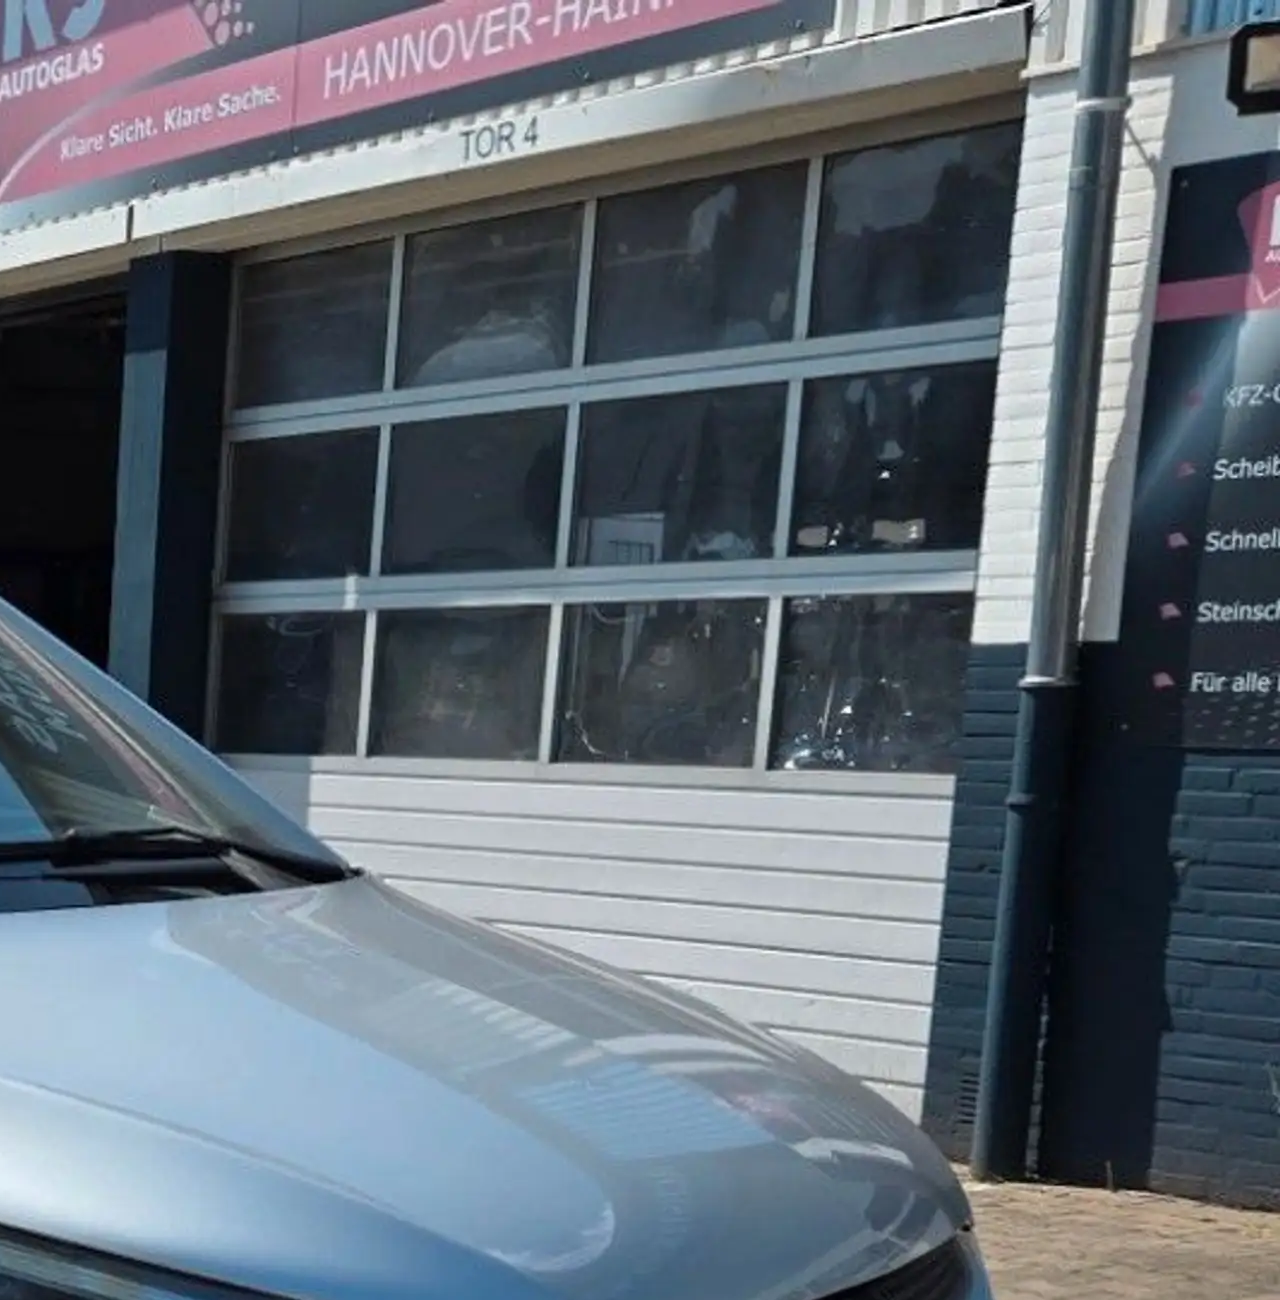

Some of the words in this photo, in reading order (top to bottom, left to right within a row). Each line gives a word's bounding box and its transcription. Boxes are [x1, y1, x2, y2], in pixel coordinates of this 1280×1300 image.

[322, 0, 674, 100] HANNOVER-HA
[60, 134, 104, 162] Klare
[108, 114, 158, 148] Sicht.
[164, 102, 214, 133] Klare
[217, 85, 281, 119] Sache.
[459, 120, 516, 161] TOR
[524, 115, 539, 148] 4
[1190, 671, 1226, 693] Für
[1231, 671, 1272, 693] alle
